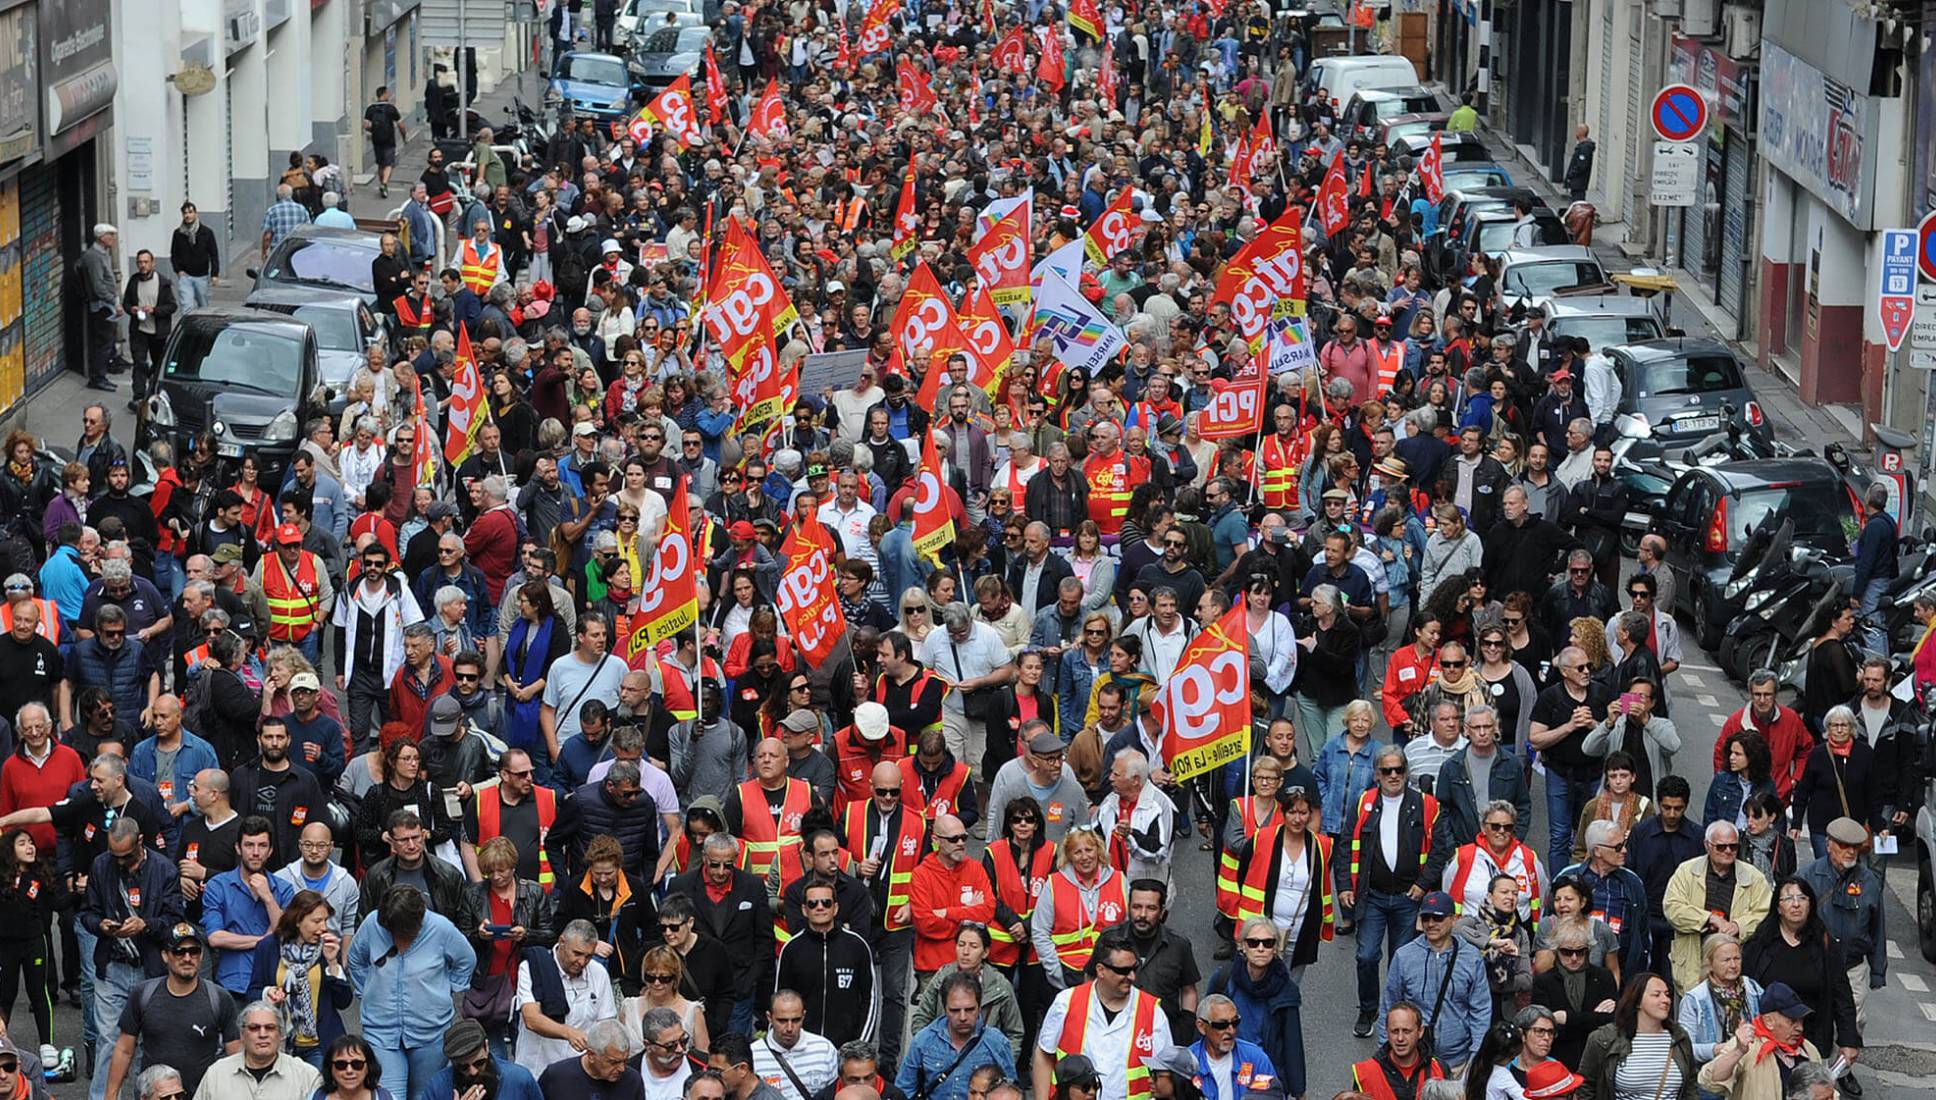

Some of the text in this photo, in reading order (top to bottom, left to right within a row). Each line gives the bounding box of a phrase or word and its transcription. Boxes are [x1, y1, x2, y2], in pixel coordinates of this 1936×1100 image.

[1894, 234, 1909, 256] P
[1886, 255, 1914, 264] PAYANT
[838, 974, 853, 989] 67
